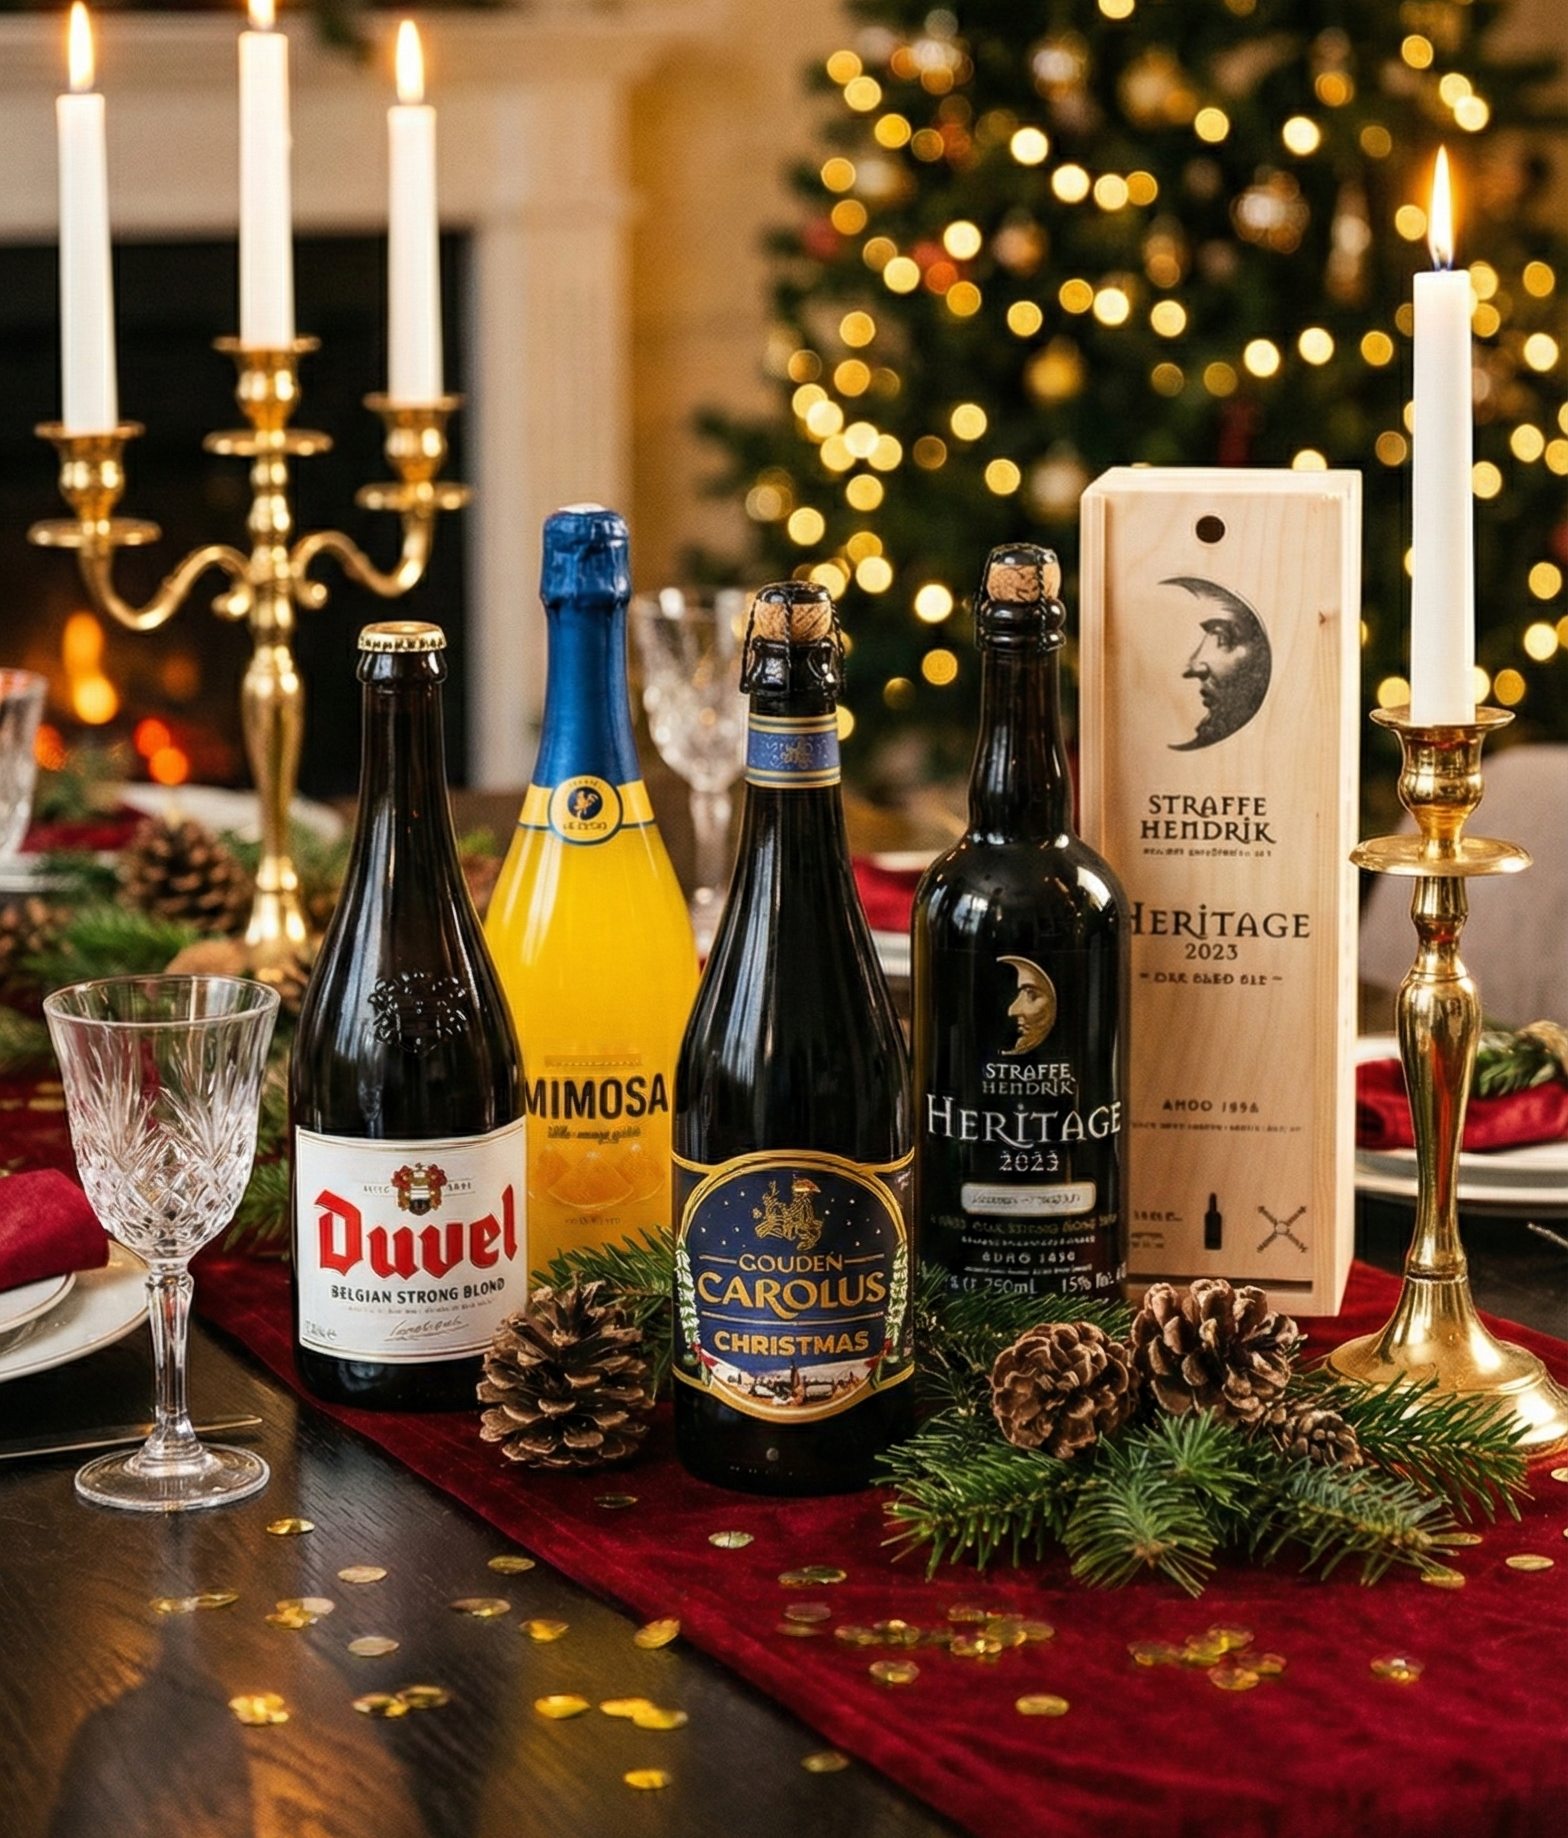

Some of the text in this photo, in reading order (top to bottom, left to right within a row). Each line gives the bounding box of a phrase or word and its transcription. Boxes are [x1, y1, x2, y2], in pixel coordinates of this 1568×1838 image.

[1148, 794, 1267, 818] STRAFFE
[1140, 817, 1277, 844] HENDRIK
[1185, 943, 1239, 961] 2023
[985, 1063, 1071, 1082] STRAFFE
[525, 1073, 669, 1120] MIMOSA
[982, 1078, 1077, 1097] HENDRIK
[926, 1093, 1122, 1149] HERITAGE
[999, 1151, 1060, 1172] 2023
[314, 1183, 518, 1281] Duvel
[738, 1251, 844, 1273] GOUDEN
[331, 1277, 506, 1305] BELGIAN STRONG BLOND
[697, 1271, 887, 1320] CAROLUS
[713, 1330, 870, 1356] CHRISTMAS
